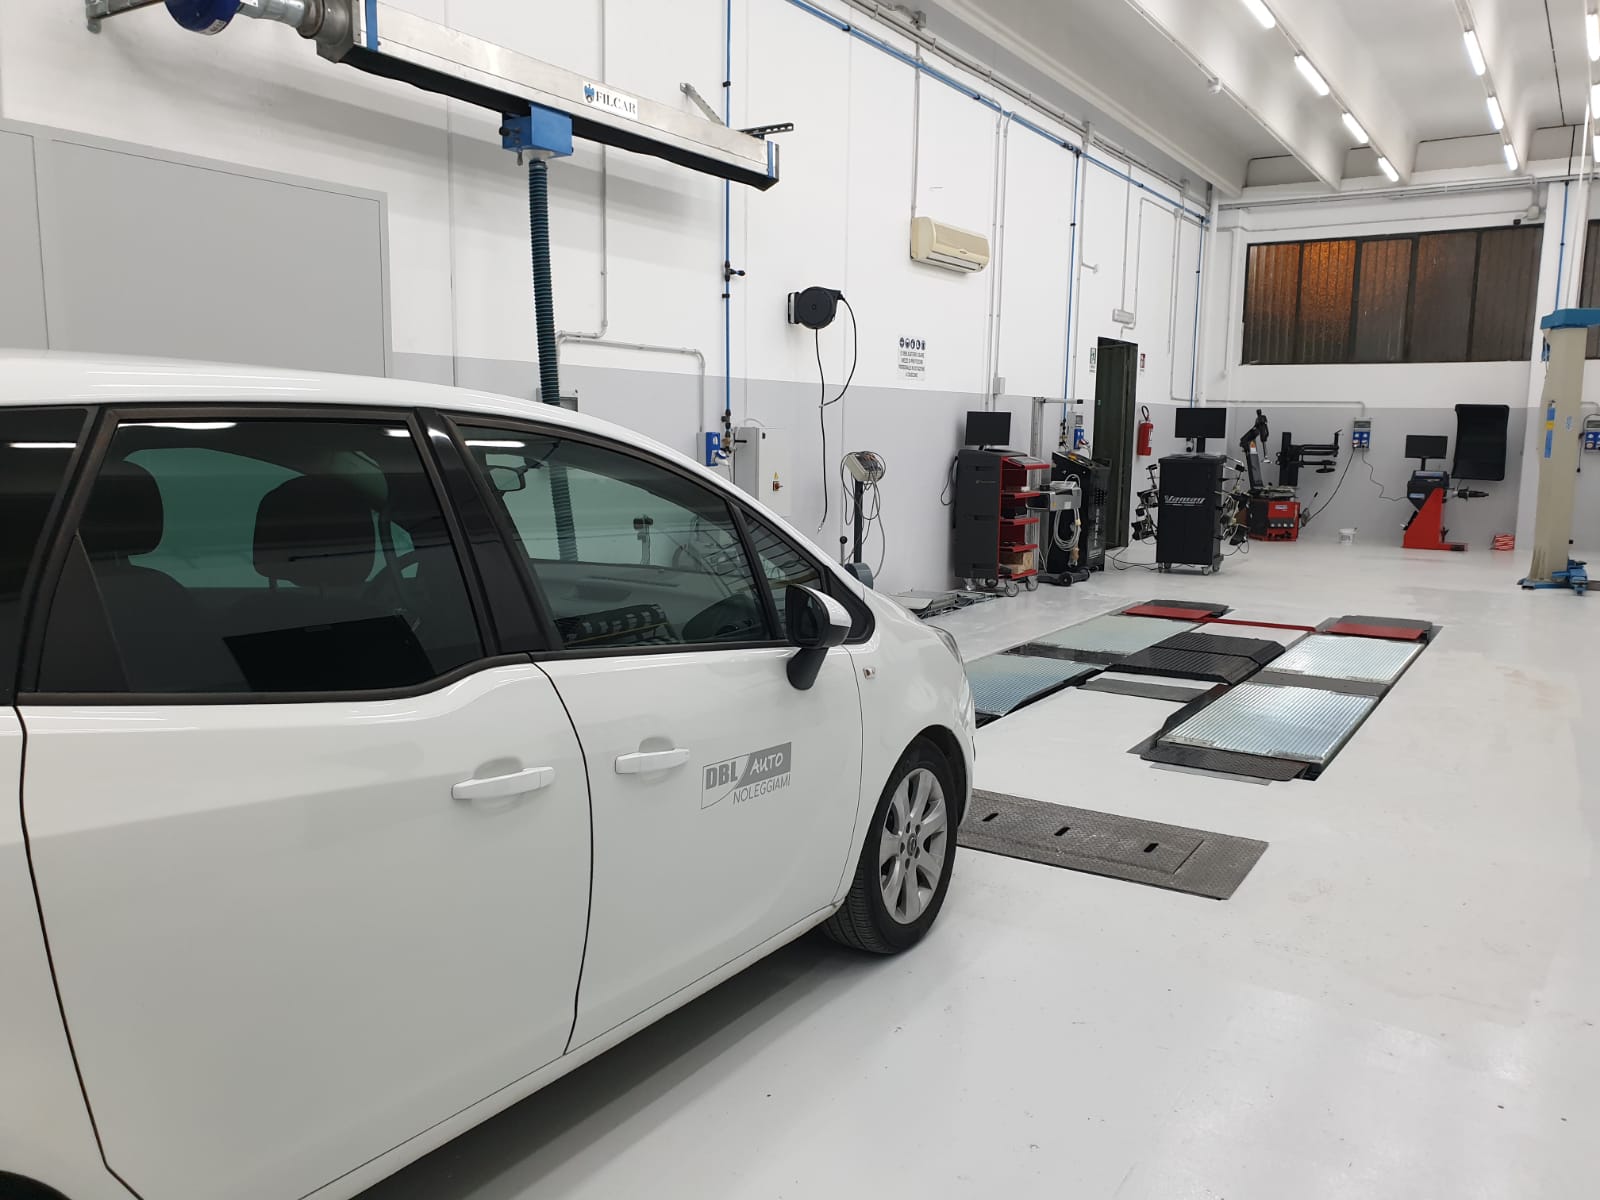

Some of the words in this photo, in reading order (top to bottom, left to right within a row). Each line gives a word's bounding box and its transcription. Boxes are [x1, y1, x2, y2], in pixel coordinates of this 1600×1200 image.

[596, 91, 636, 114] FILCAR
[705, 760, 738, 790] DBL
[750, 752, 784, 776] AUTO
[732, 773, 791, 805] NOLEGGIAMI
